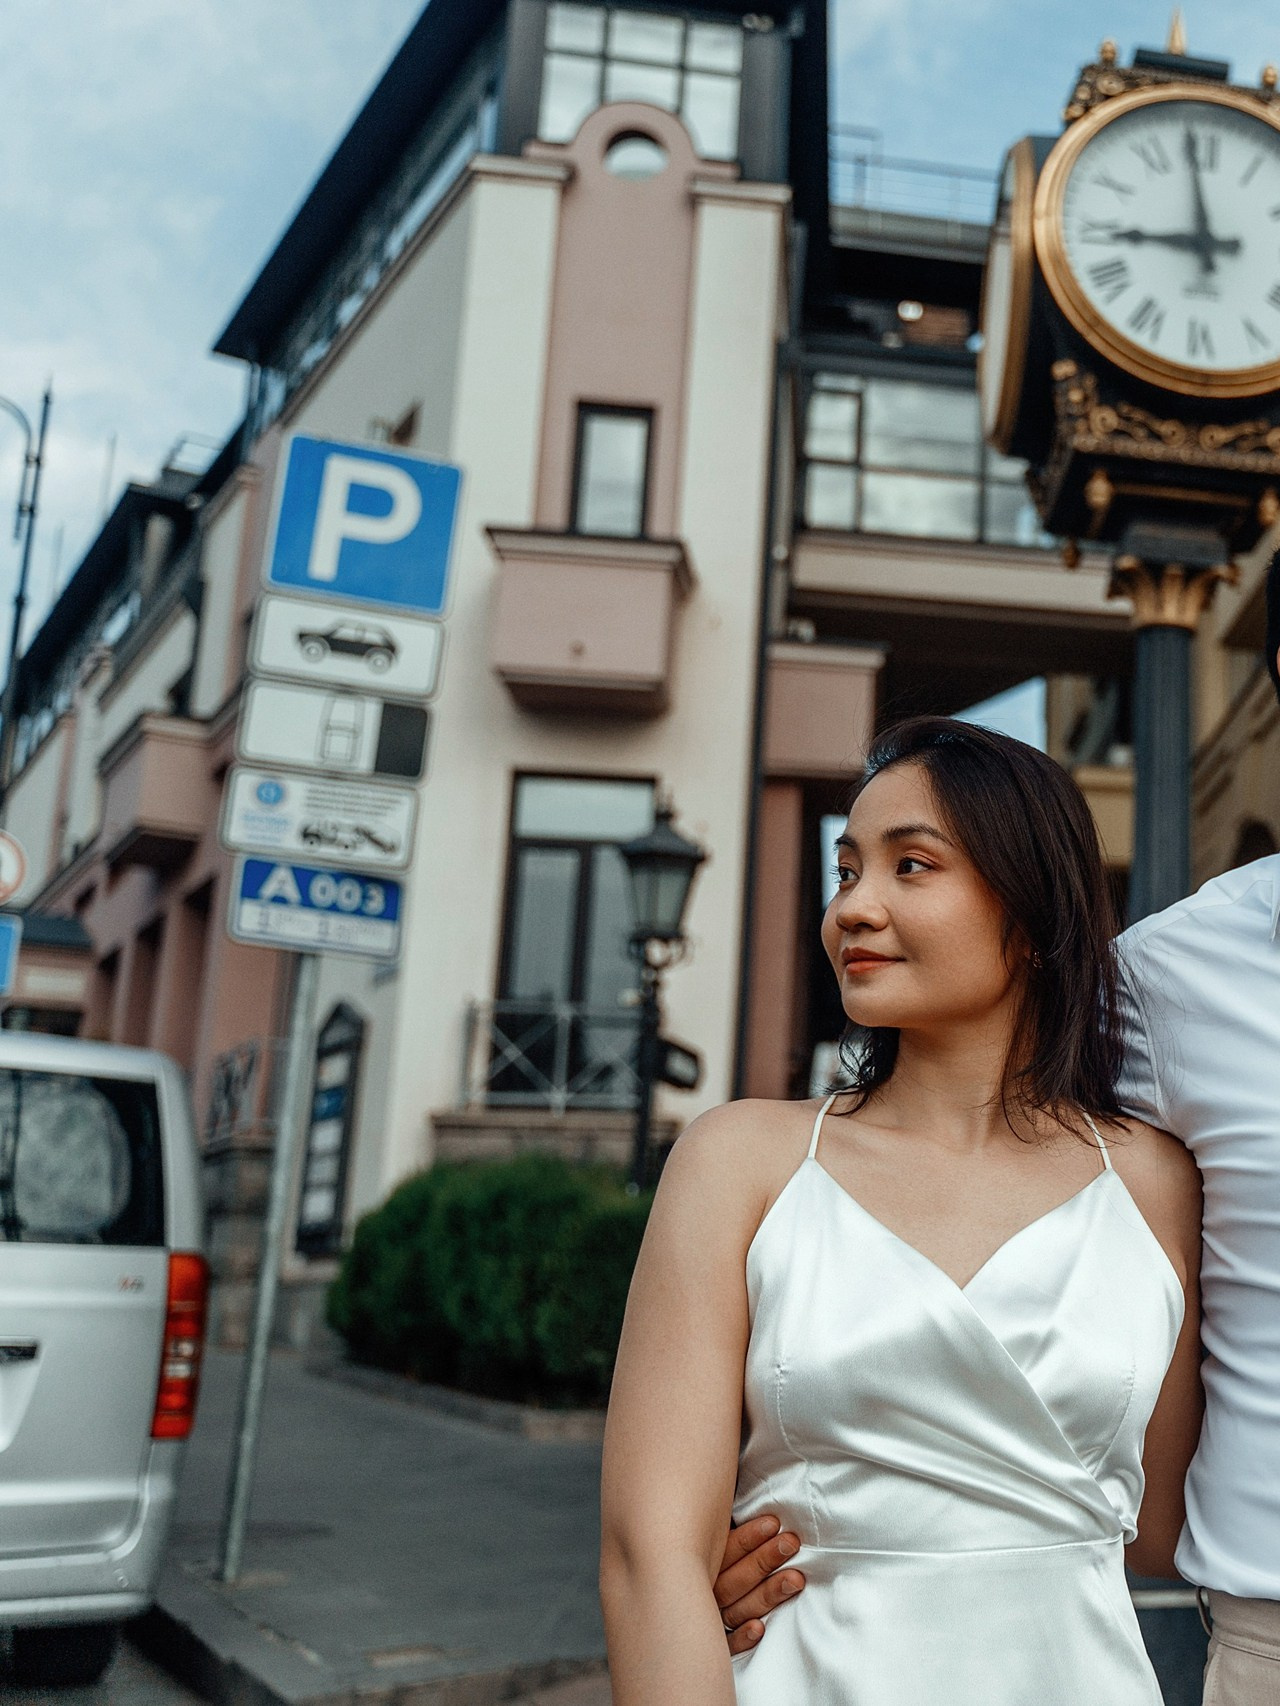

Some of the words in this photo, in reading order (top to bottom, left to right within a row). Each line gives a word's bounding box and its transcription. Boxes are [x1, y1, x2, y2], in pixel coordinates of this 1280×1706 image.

[1239, 152, 1266, 189] I
[1087, 259, 1133, 305] VIII
[1126, 296, 1167, 343] VII
[1186, 316, 1217, 359] VI
[307, 452, 423, 583] P
[257, 863, 302, 905] A
[309, 872, 387, 917] 003
